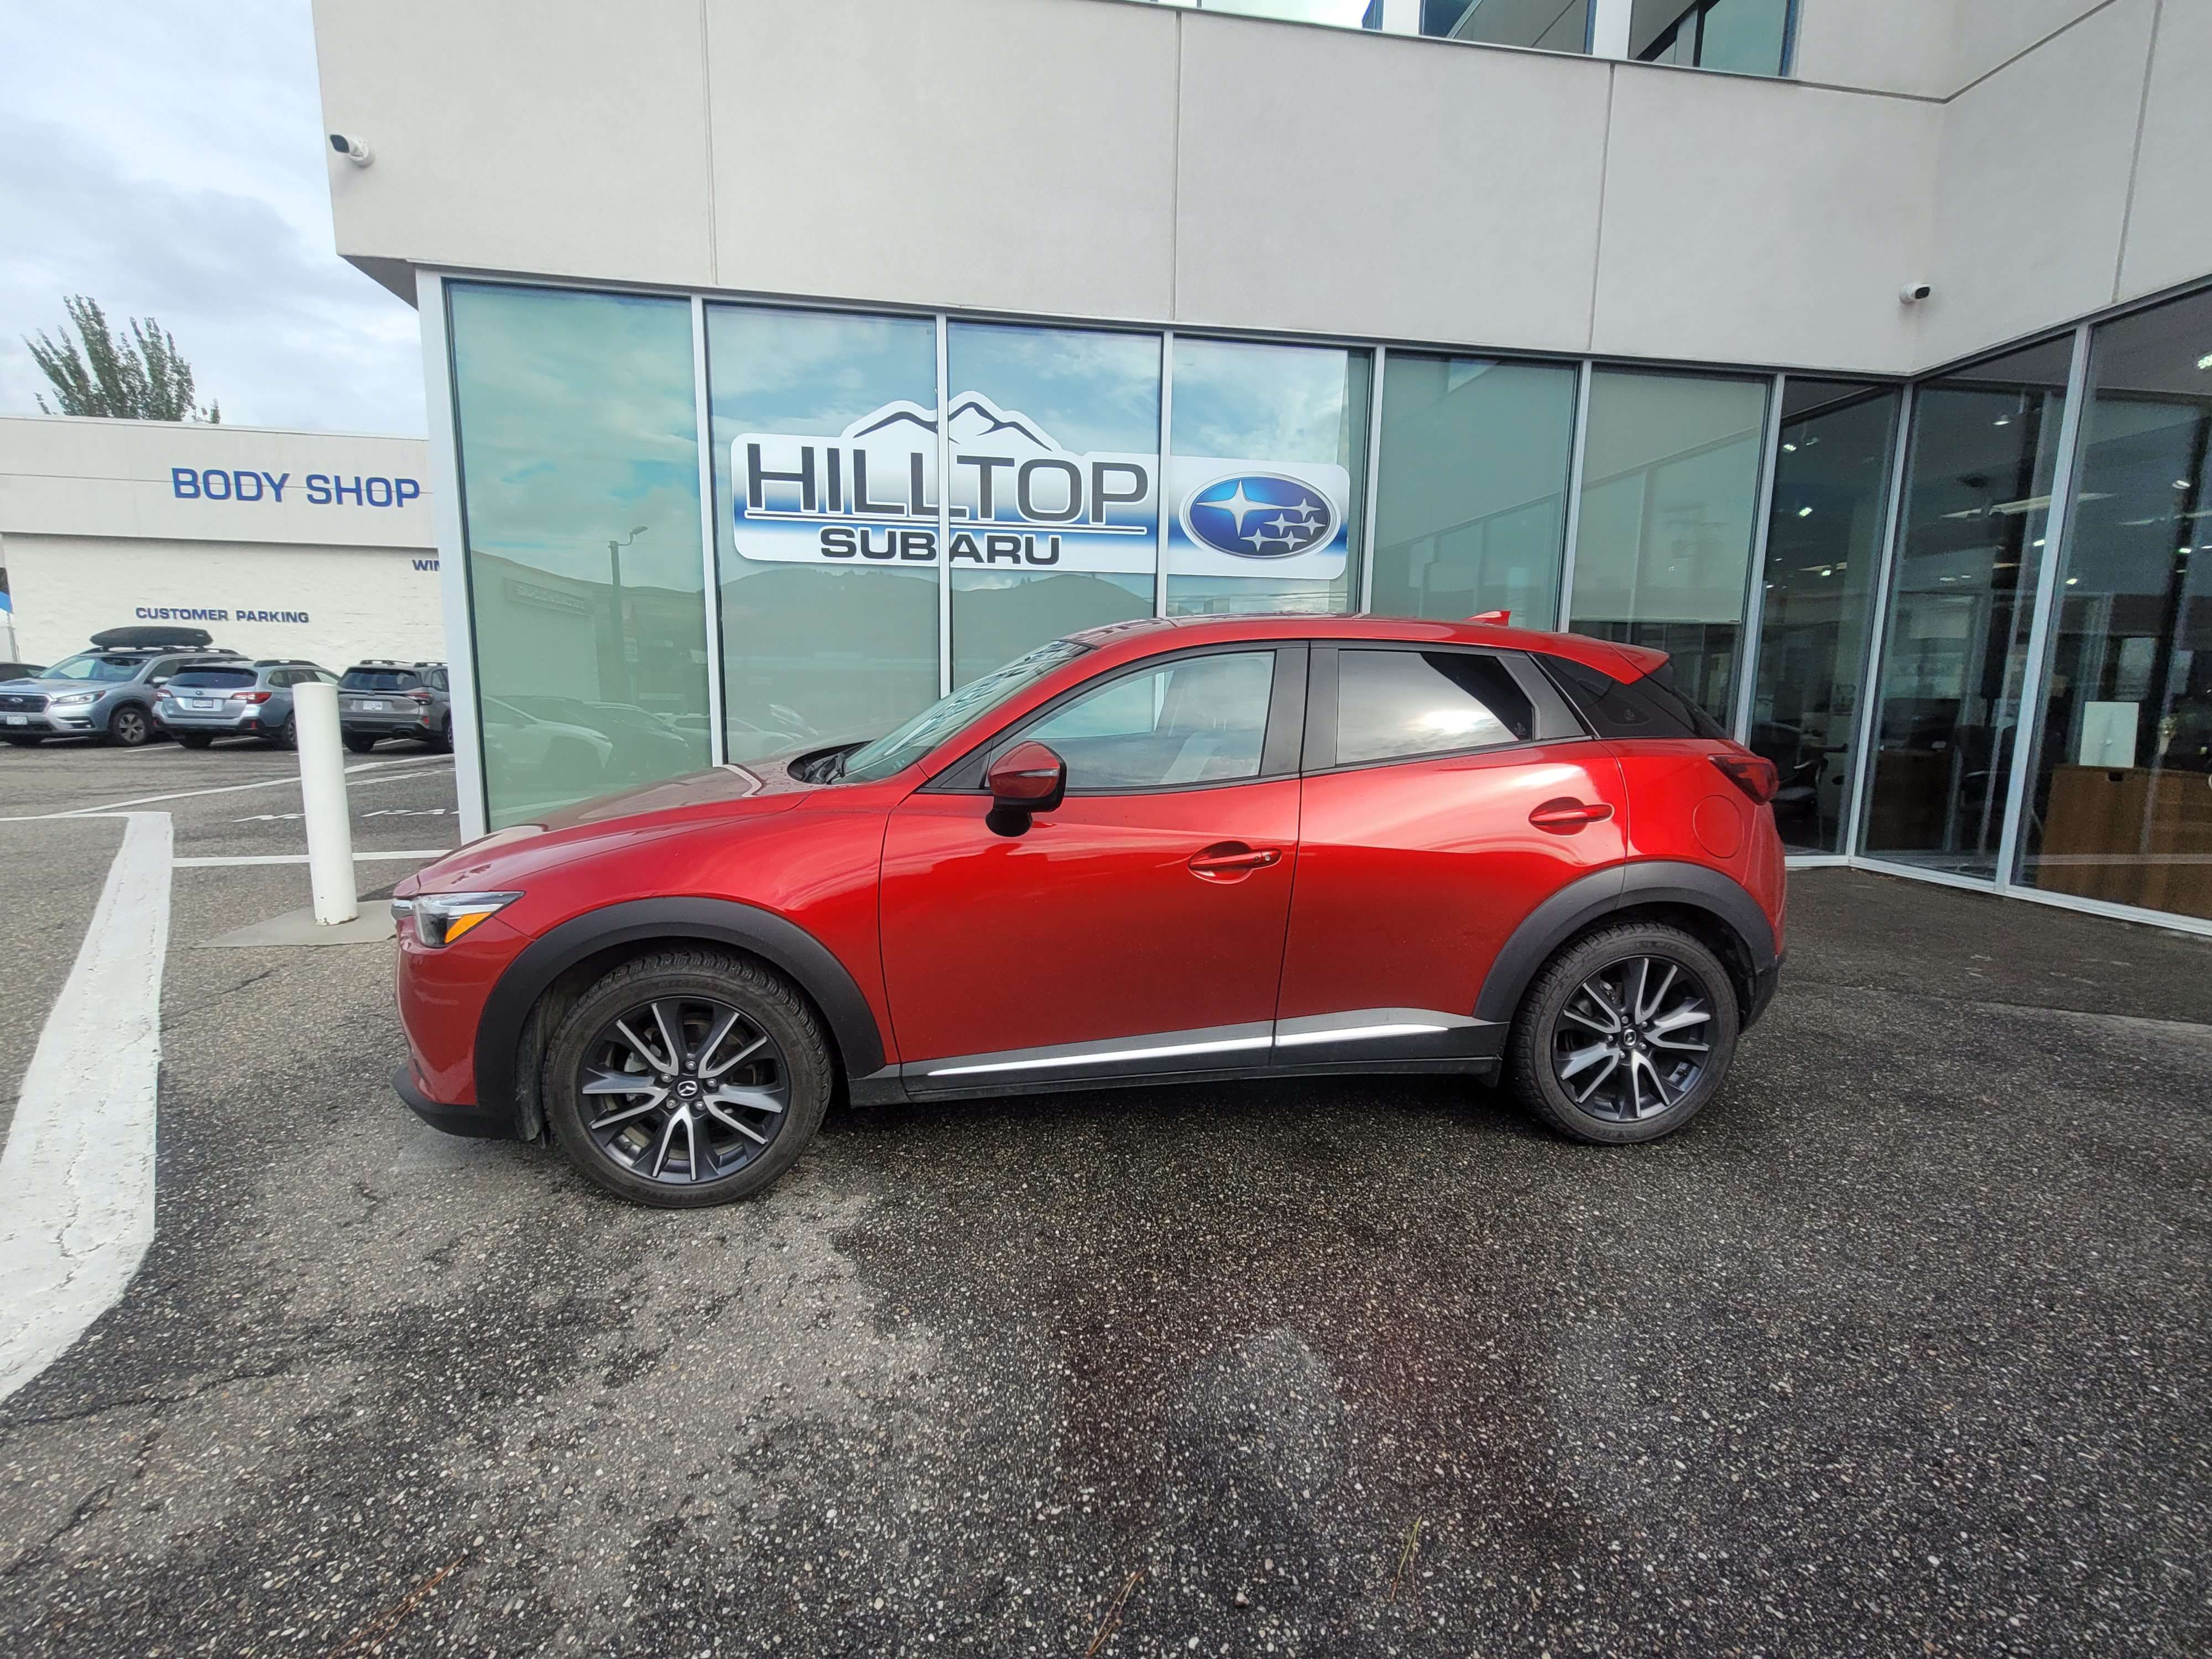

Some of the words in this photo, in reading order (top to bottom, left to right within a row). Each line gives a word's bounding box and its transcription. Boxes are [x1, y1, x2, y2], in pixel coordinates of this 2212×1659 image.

[171, 468, 290, 503] BODY
[306, 474, 420, 508] SHOP
[747, 443, 1149, 524] HILLTOP
[821, 528, 1060, 565] SUBARU
[135, 607, 229, 620] CUSTOMER
[236, 610, 309, 623] PARKING
